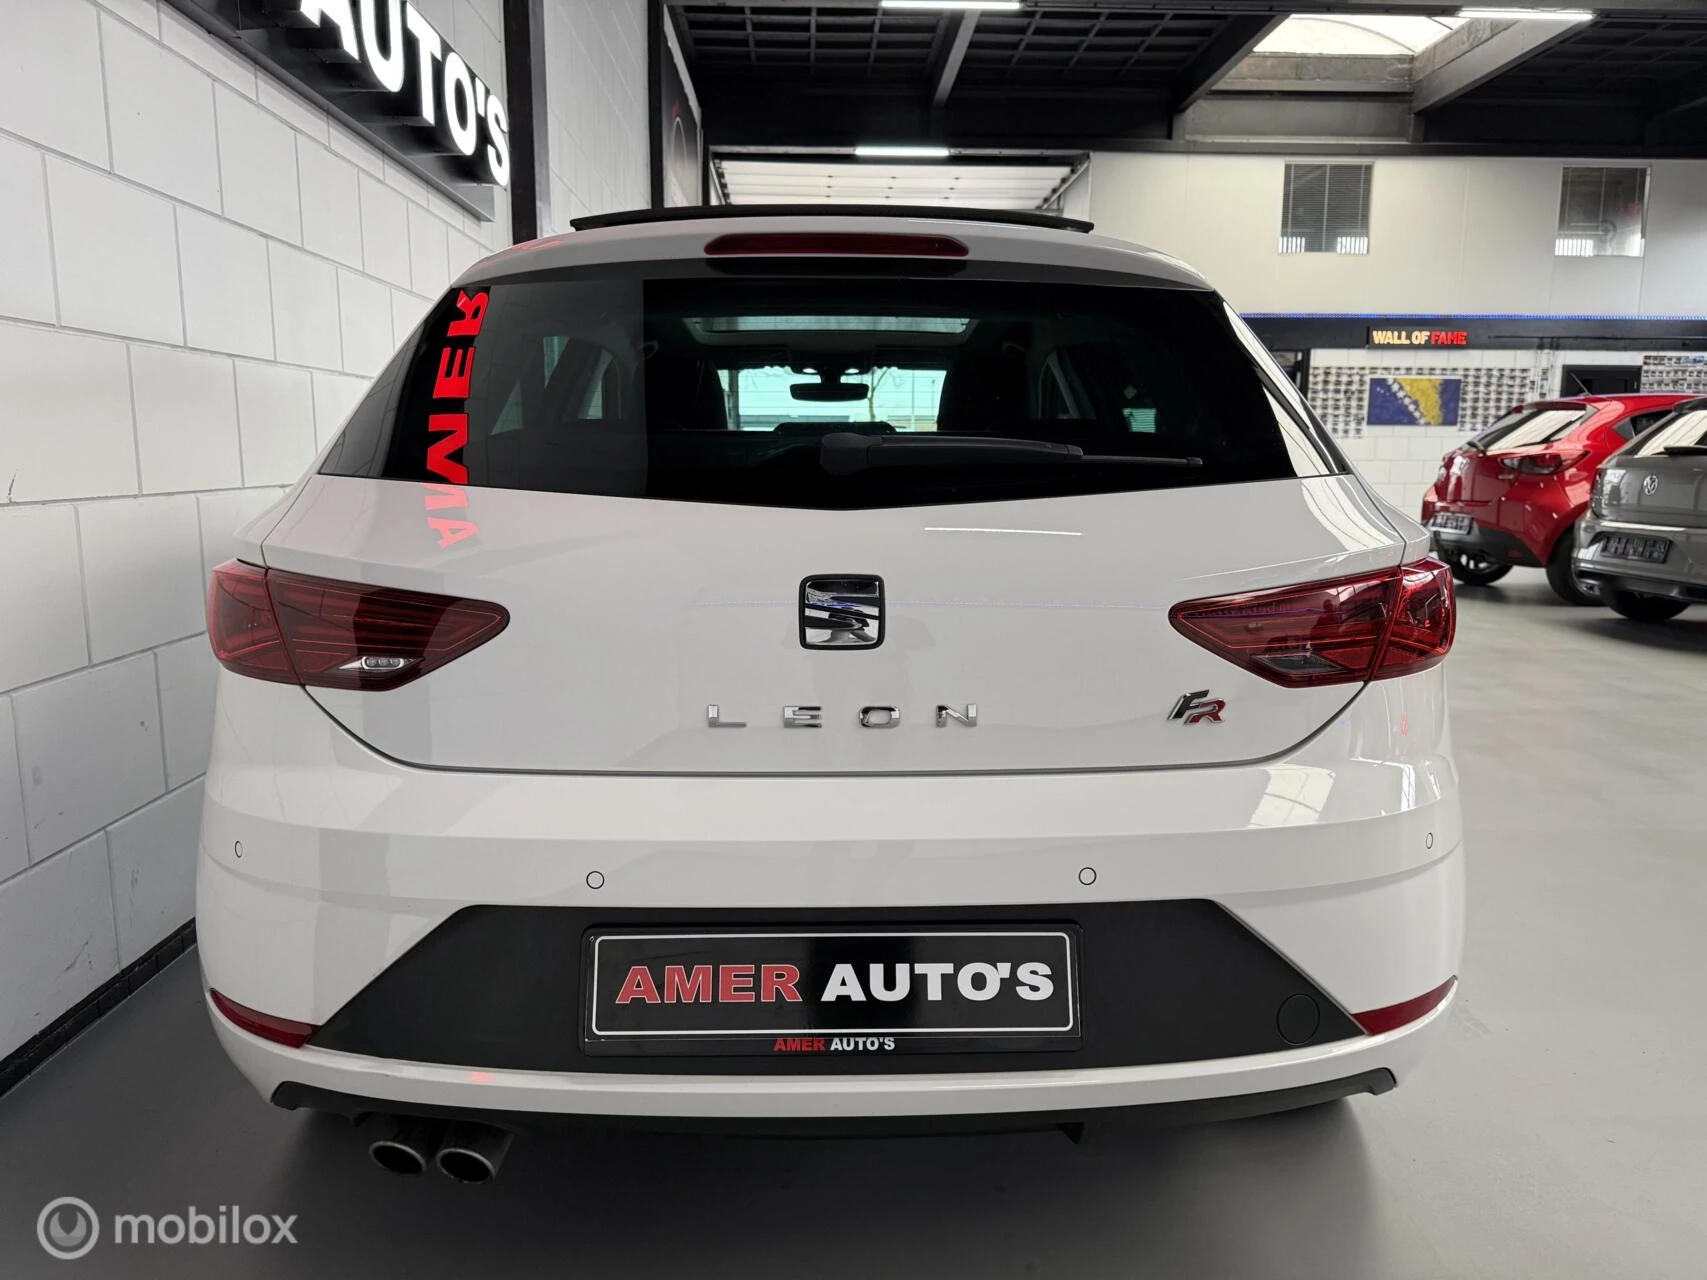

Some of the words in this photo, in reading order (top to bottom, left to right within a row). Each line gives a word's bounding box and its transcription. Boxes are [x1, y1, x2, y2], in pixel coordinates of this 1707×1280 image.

[1372, 330, 1410, 345] WALL
[1411, 330, 1431, 345] OF
[1431, 331, 1468, 345] FAME
[708, 704, 978, 729] LEON
[1166, 689, 1226, 725] FR
[615, 963, 803, 1005] AMER
[820, 962, 1054, 1002] AUTO'S
[773, 1036, 826, 1052] AMER
[829, 1036, 896, 1052] AUTO'S
